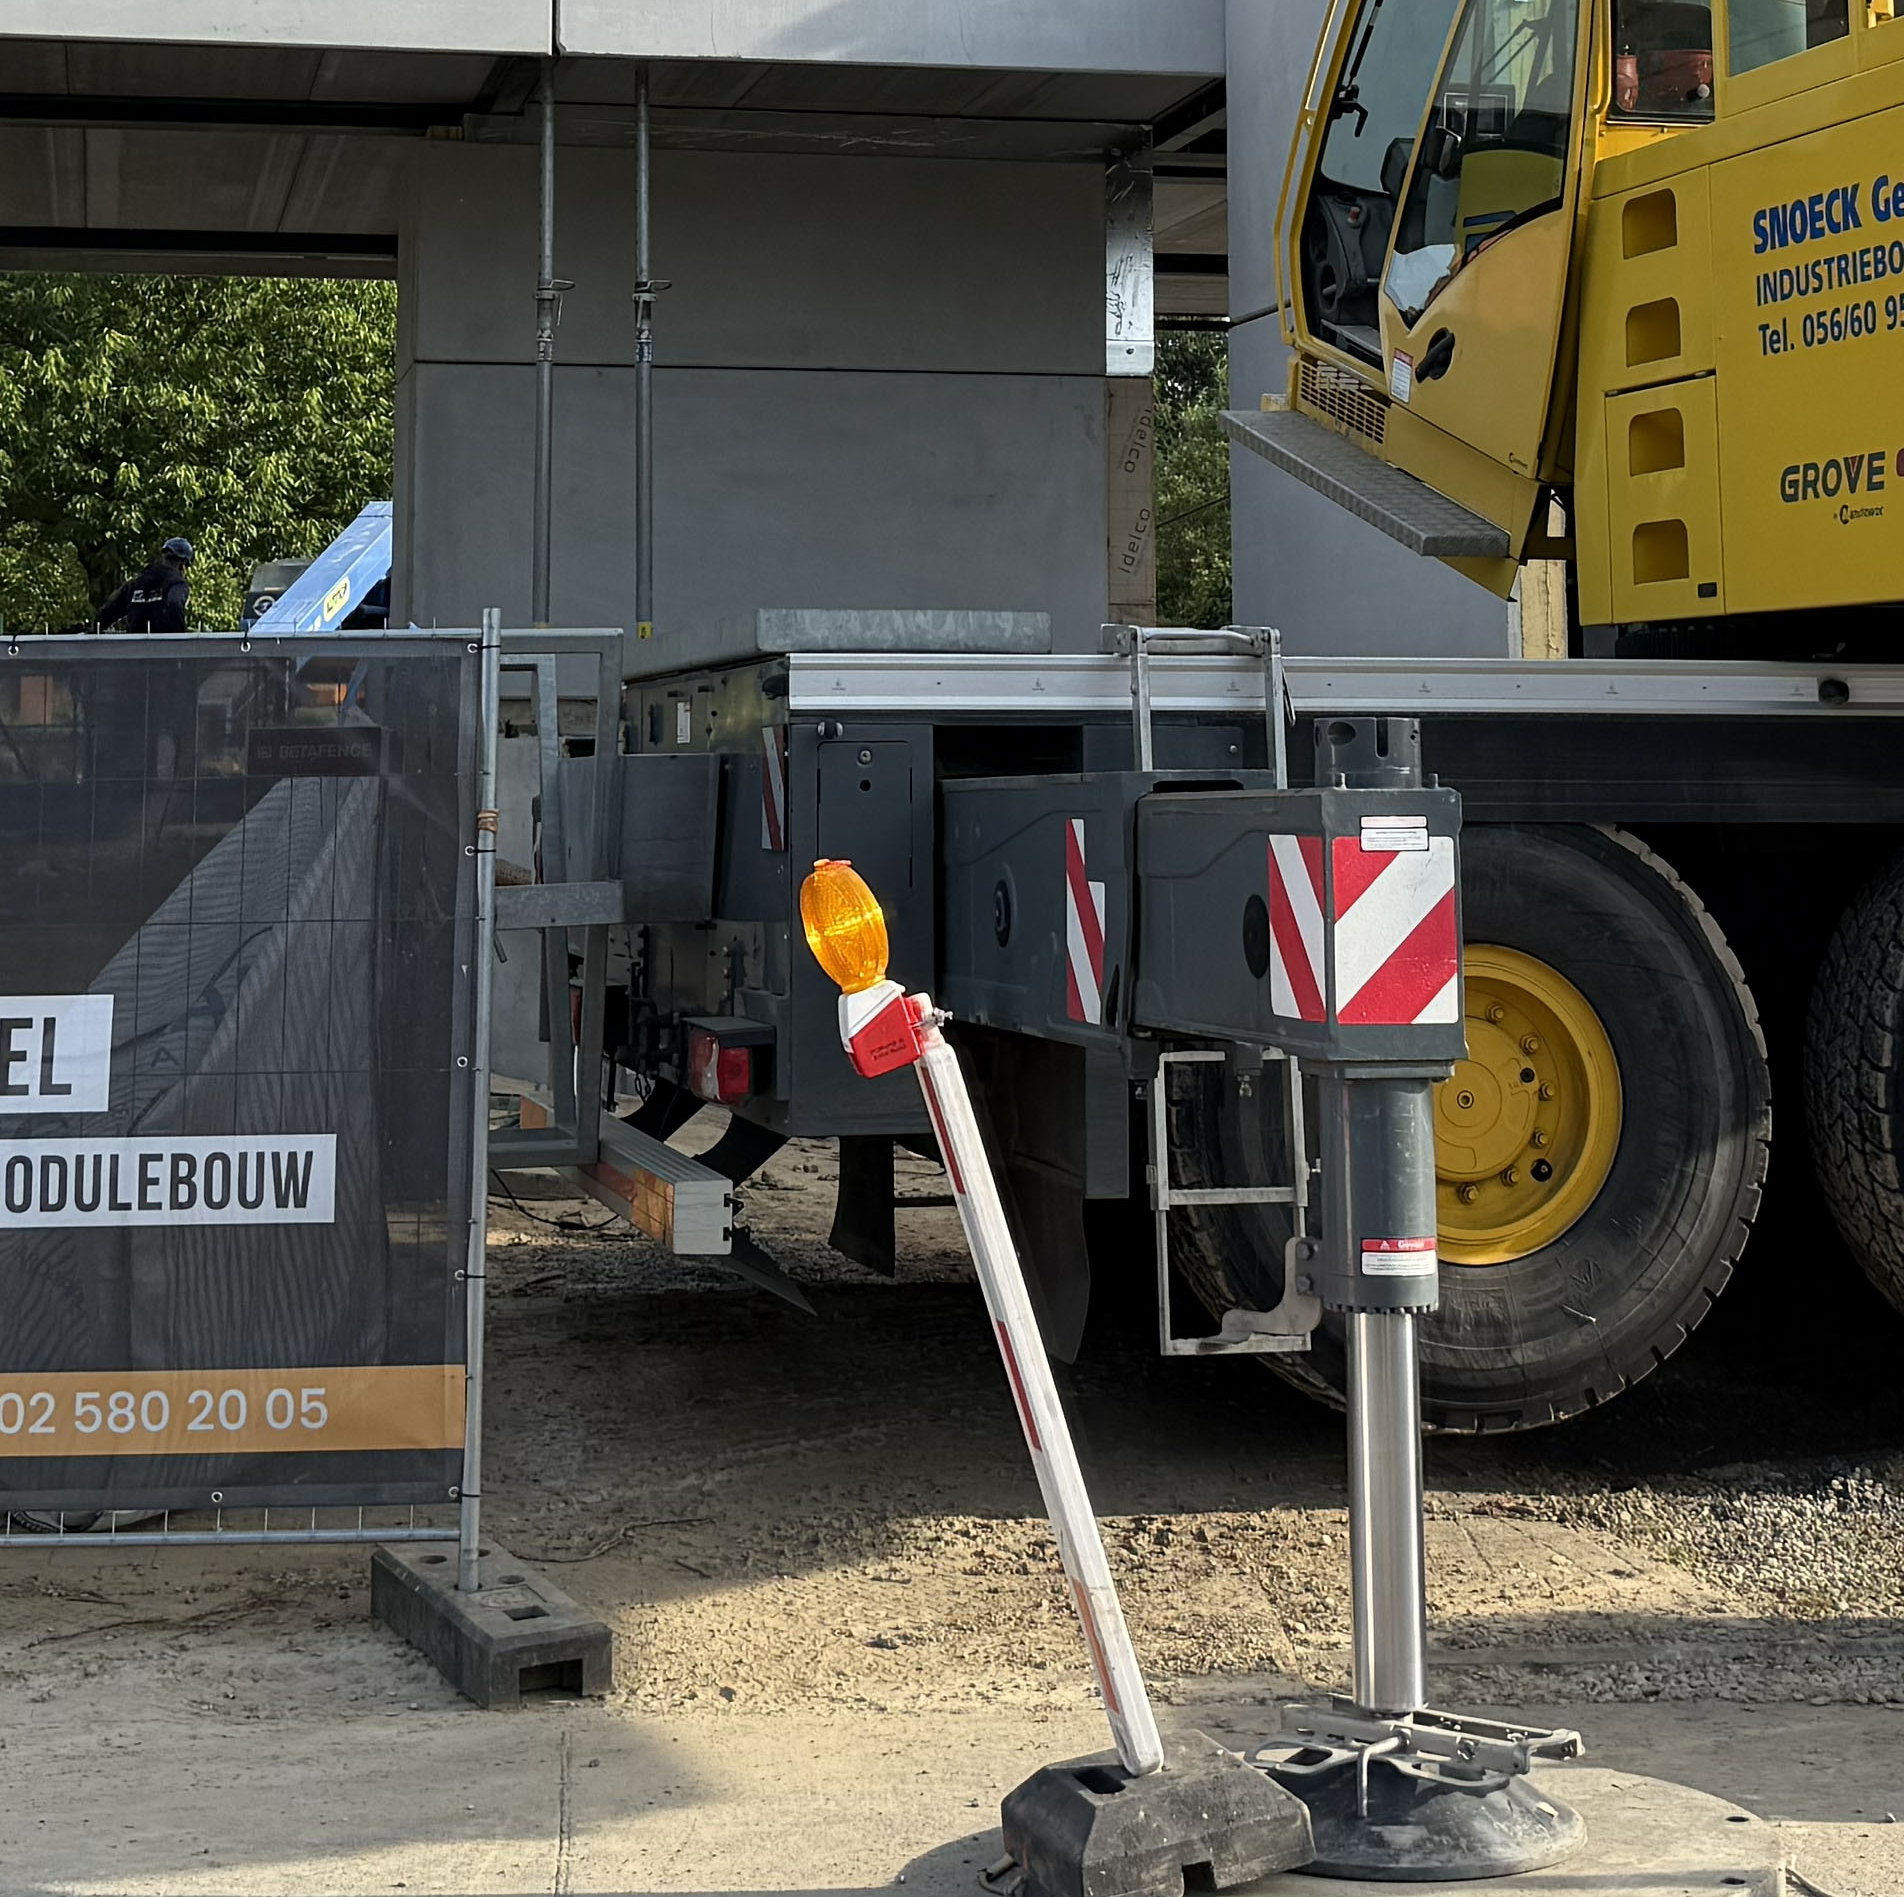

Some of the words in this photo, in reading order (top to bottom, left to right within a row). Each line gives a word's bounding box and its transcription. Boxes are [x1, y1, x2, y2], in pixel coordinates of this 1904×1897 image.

[1752, 183, 1861, 255] SNOECK
[1759, 320, 1795, 357] Tel.
[1802, 307, 1877, 350] 056/60
[1780, 451, 1886, 503] GROVE
[73, 1389, 171, 1434] 580
[186, 1388, 255, 1432] 20
[265, 1387, 329, 1431] 05
